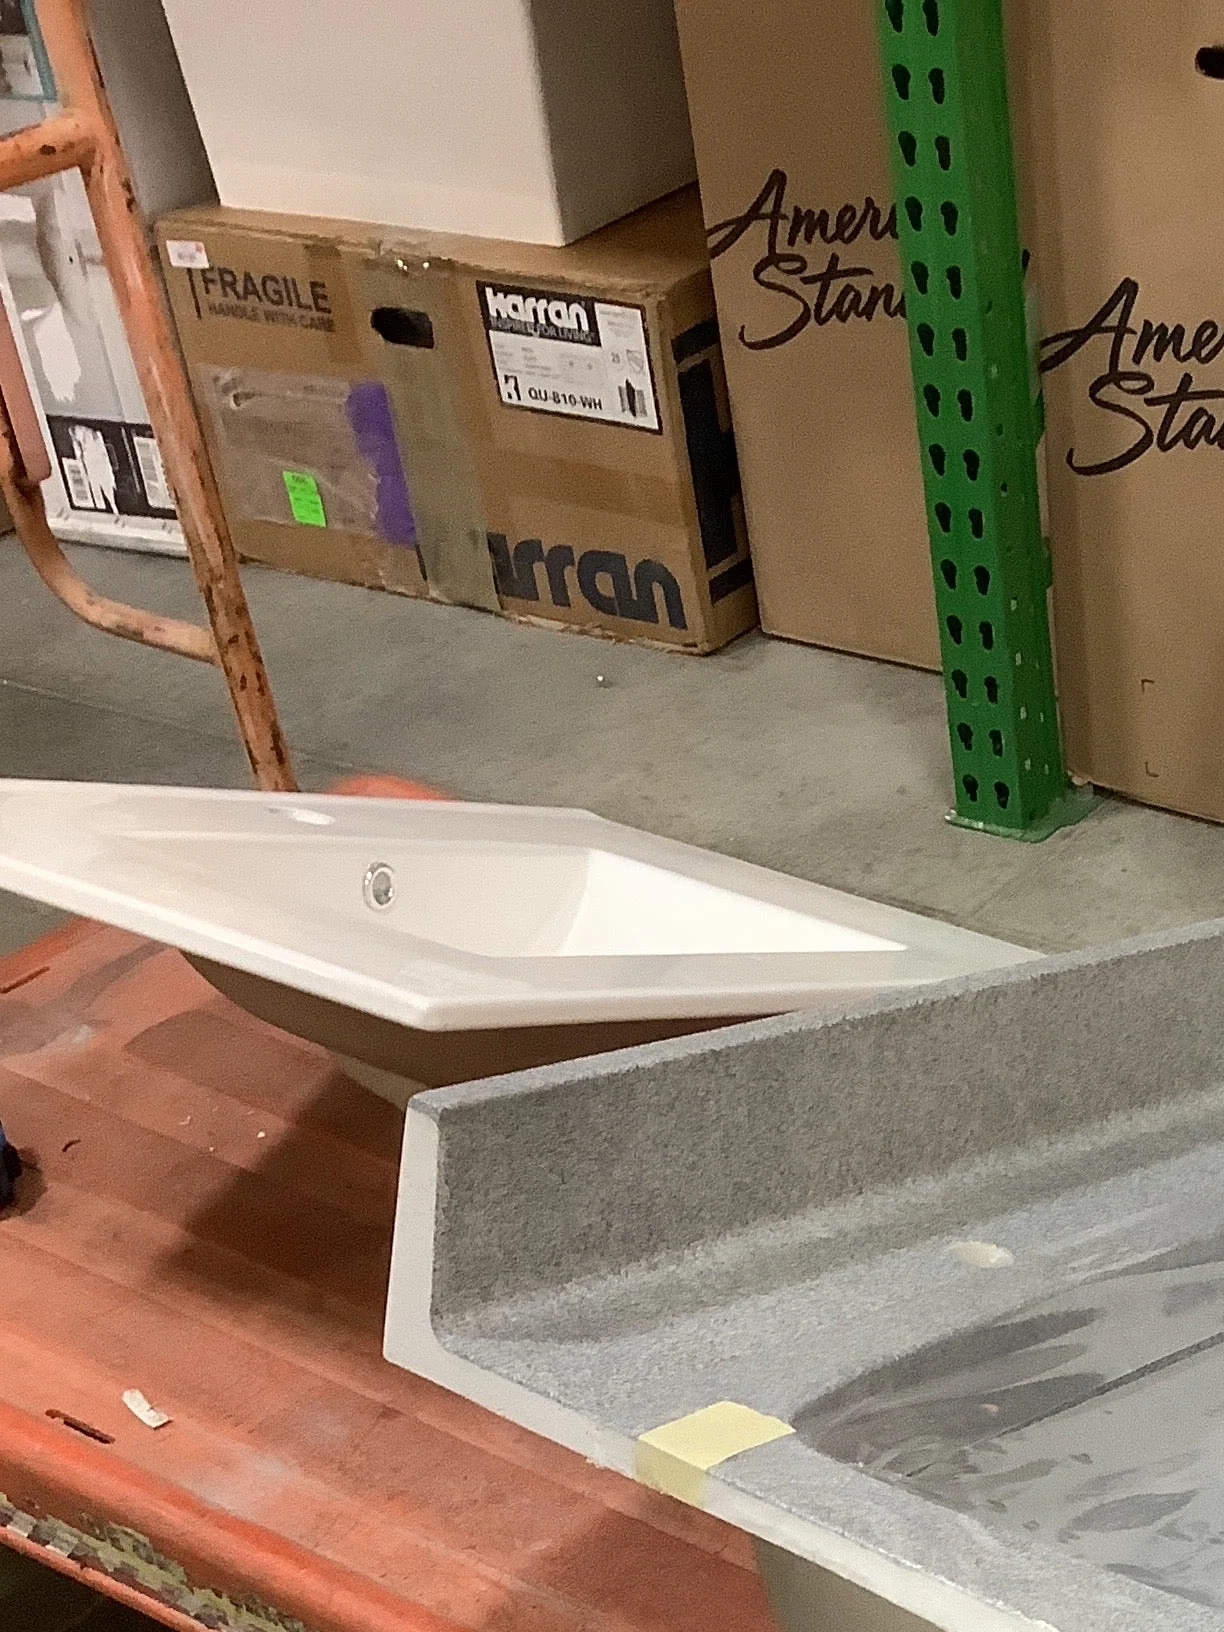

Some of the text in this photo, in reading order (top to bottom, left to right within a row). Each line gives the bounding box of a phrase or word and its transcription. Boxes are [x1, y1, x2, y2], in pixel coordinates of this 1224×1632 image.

[707, 168, 899, 260] Ameri
[200, 265, 333, 314] FRAGILE
[485, 286, 590, 332] karran
[738, 252, 907, 351] Stan
[487, 531, 688, 630] rran
